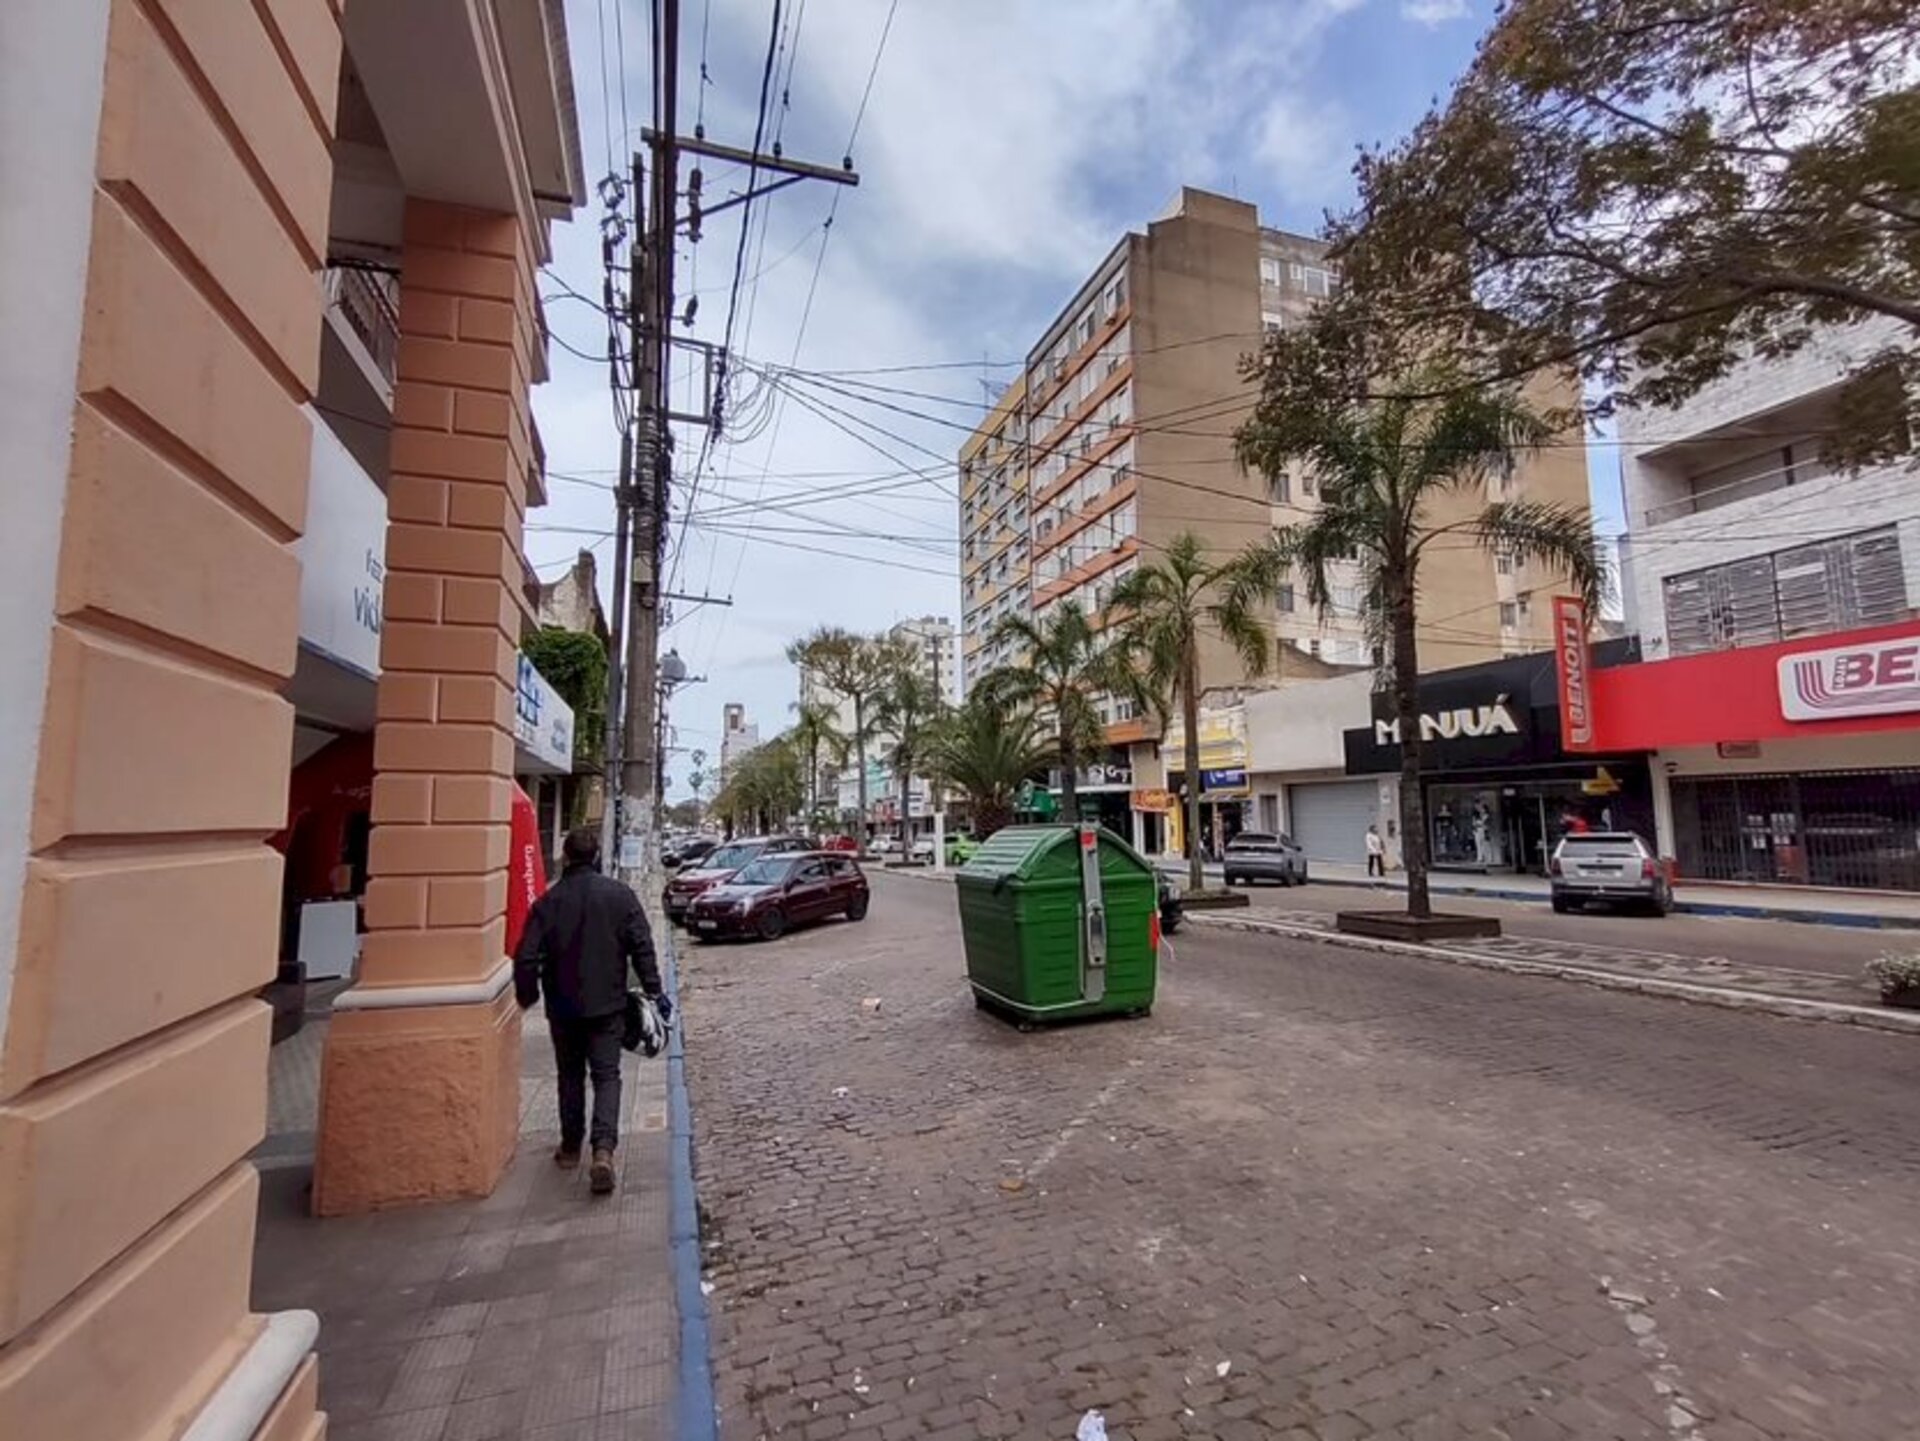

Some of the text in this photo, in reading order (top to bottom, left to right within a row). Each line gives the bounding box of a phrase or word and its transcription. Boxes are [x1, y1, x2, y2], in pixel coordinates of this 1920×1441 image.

[1562, 619, 1585, 729] BENOIT
[1832, 646, 1920, 691] BE
[1375, 693, 1519, 746] MNJUÁ
